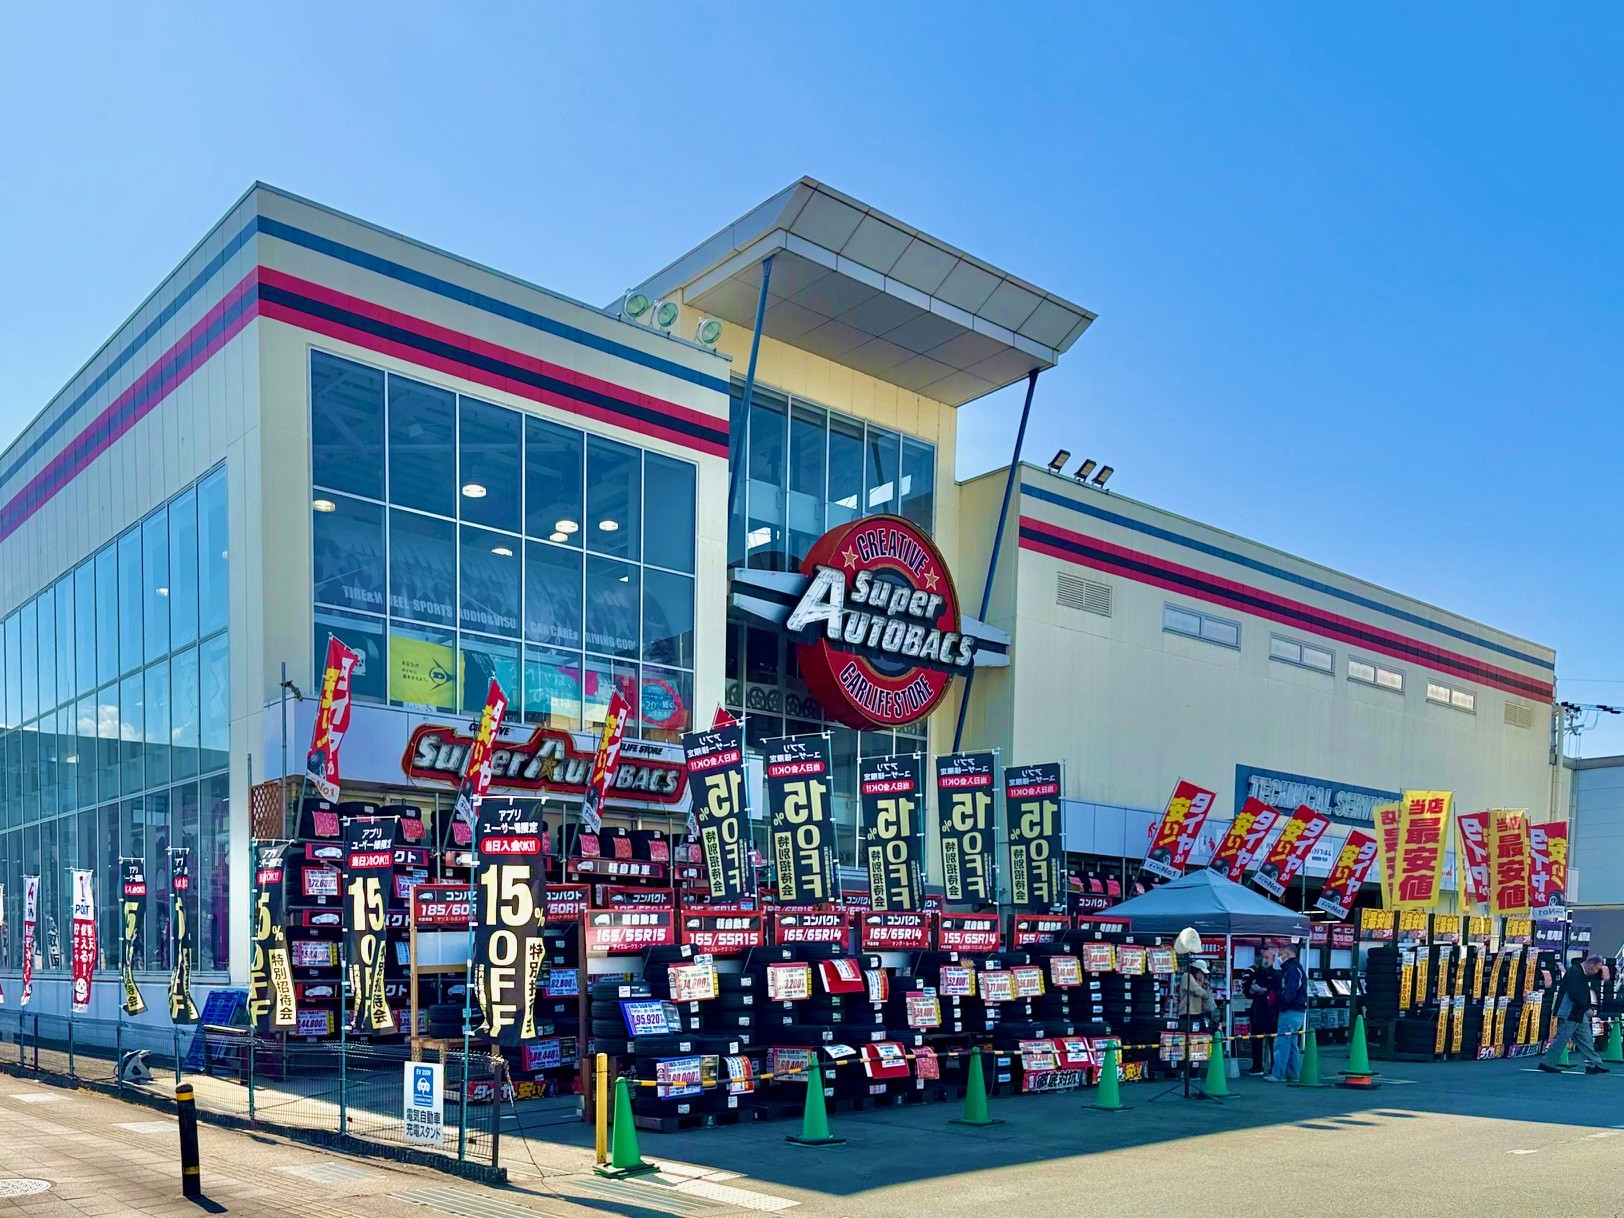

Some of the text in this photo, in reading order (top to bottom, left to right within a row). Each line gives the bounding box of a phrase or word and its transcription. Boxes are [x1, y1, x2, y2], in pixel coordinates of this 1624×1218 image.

[856, 529, 929, 578] CREATIVE
[850, 570, 944, 619] Super
[458, 608, 517, 629] AUDIO&VISU
[786, 565, 976, 666] AUTOBACS
[840, 661, 934, 718] CARLIFE STORE
[639, 744, 663, 756] STORE
[411, 734, 681, 796] Suer AUBACS
[1249, 775, 1332, 814] TECHNICAL
[499, 809, 522, 821] アプリ
[1408, 798, 1445, 815] 当店
[362, 827, 382, 839] アプリ
[1173, 792, 1212, 863] タイヤが
[1230, 810, 1277, 876] タイヤが
[1280, 818, 1327, 881] タイヤが
[1398, 817, 1442, 901] 最安値
[608, 862, 651, 876] 軽自動車
[1342, 841, 1378, 904] タイヤが
[1497, 833, 1526, 910] 最安値
[632, 894, 667, 903] コンパクト
[846, 896, 870, 904] コンパク
[1079, 898, 1107, 907] コンパクト
[621, 914, 658, 925] 軽自動車
[716, 918, 750, 929] 軽自動車
[802, 915, 840, 926] コンパクト
[887, 915, 921, 926] コンパクト
[596, 928, 667, 942] 165/55R15
[689, 933, 758, 946] 165/55R15
[783, 929, 842, 941] 165/65R14
[869, 928, 922, 940] 165/65R14
[944, 933, 997, 944] 155/65R14
[271, 952, 294, 1020] 特別招待会
[488, 930, 518, 1038] OFF
[406, 1108, 441, 1125] 電気自動車
[406, 1123, 441, 1140] 充電スタンド
